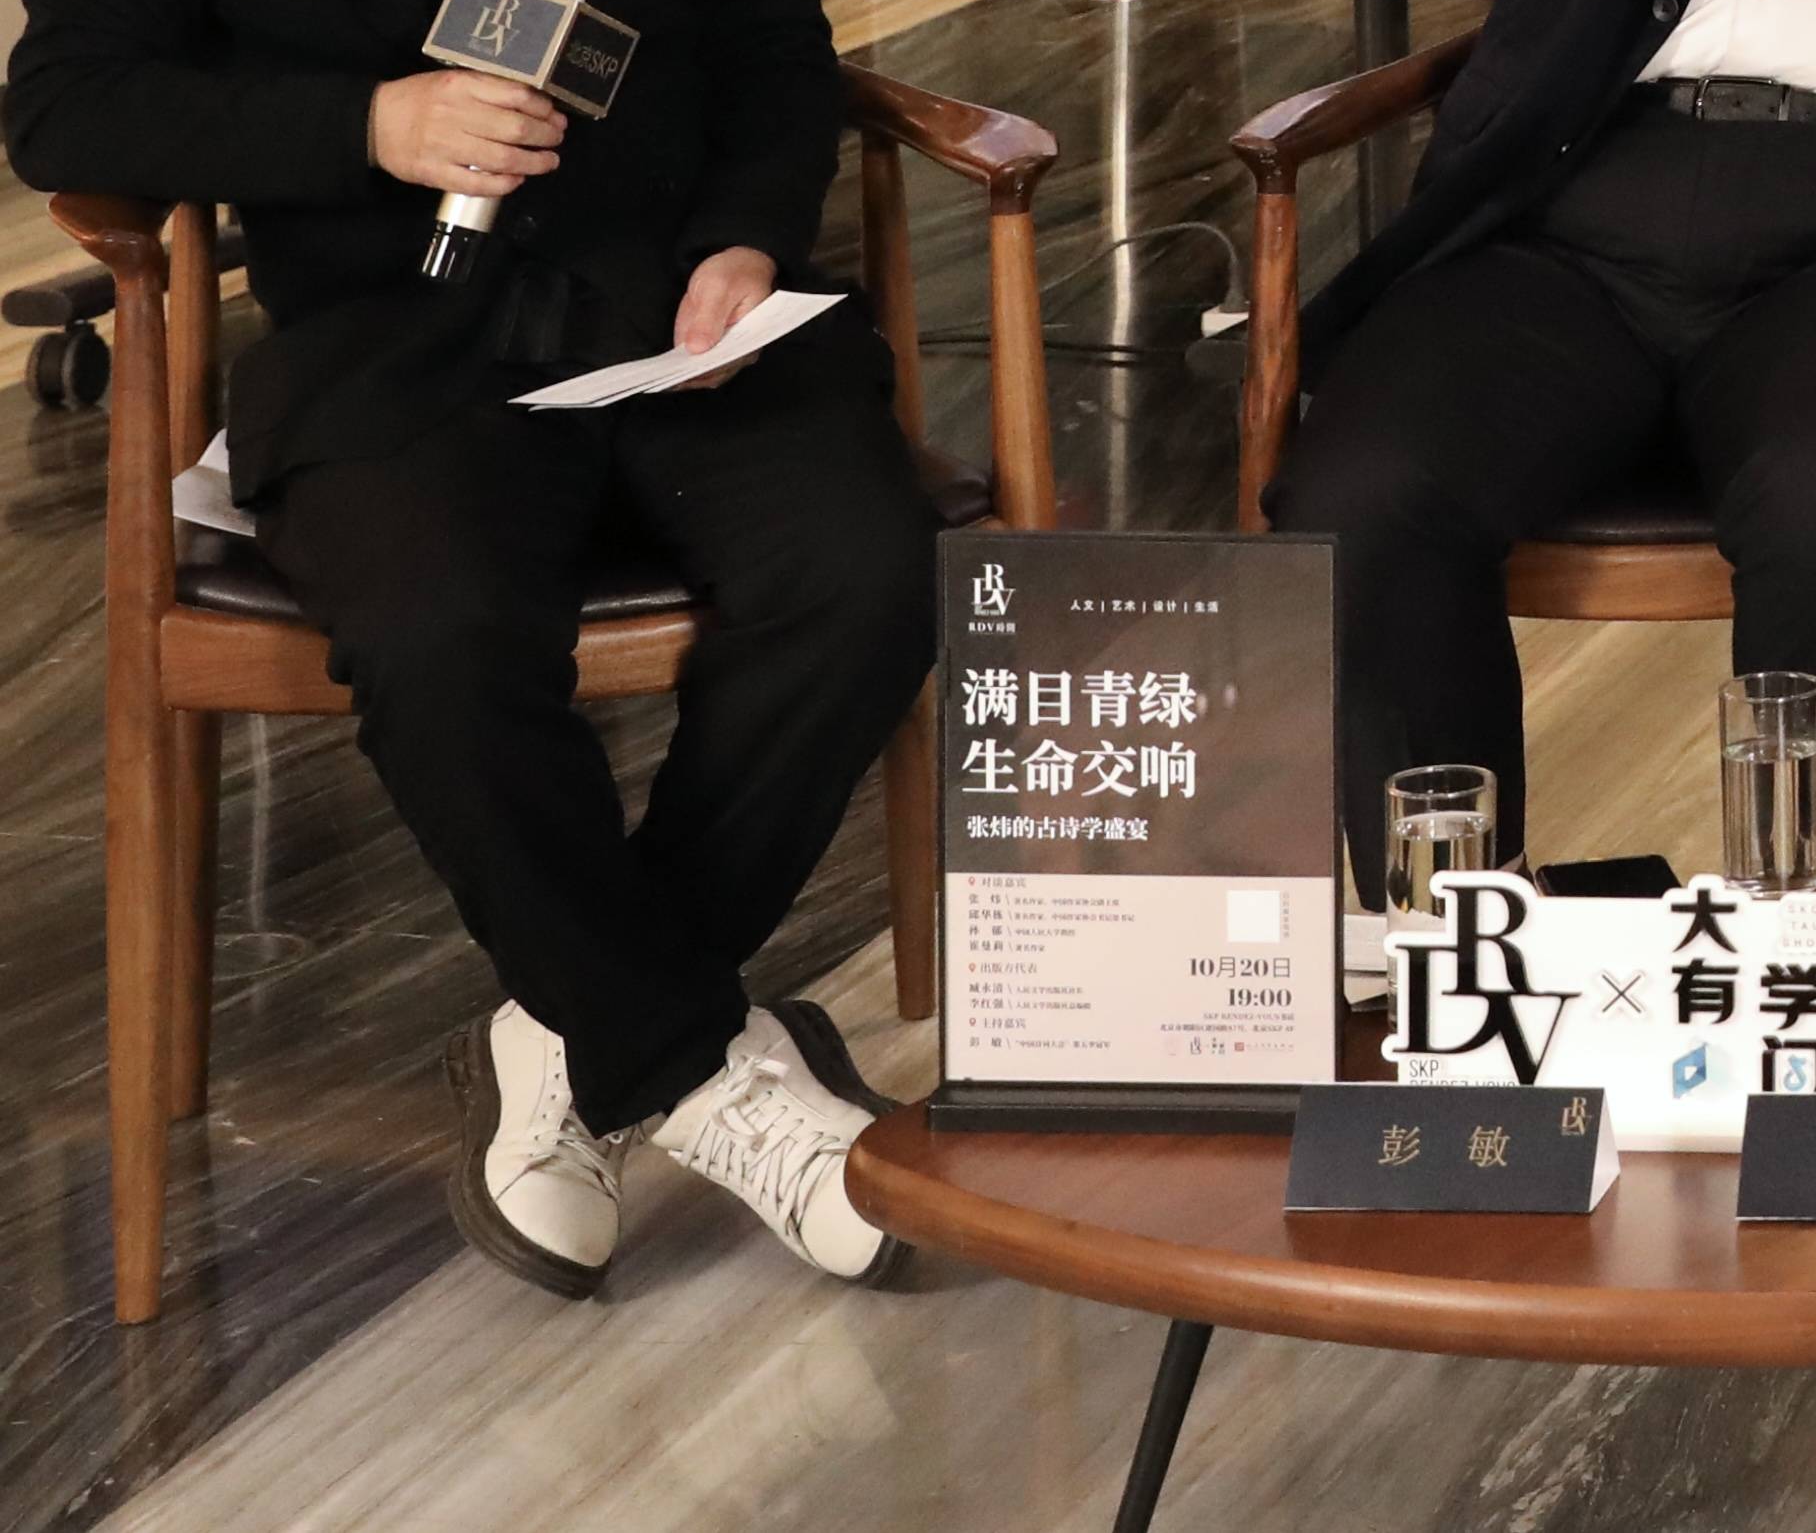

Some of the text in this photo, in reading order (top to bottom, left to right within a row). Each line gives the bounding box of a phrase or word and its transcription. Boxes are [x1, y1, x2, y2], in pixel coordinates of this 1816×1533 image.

[971, 564, 1016, 615] RDV
[1070, 600, 1095, 612] 人文
[1112, 600, 1136, 612] 艺术
[1153, 601, 1177, 612] 设计
[961, 668, 1198, 729] 满目青绿
[961, 739, 1198, 799] 生命交响
[966, 815, 1149, 842] 张炜的古诗学盛宴
[1189, 956, 1291, 978] 10月20日
[1228, 988, 1293, 1007] 19:00
[1393, 885, 1582, 1085] RDV
[1409, 1059, 1439, 1078] SKP
[1378, 1124, 1511, 1168] 彭敏
